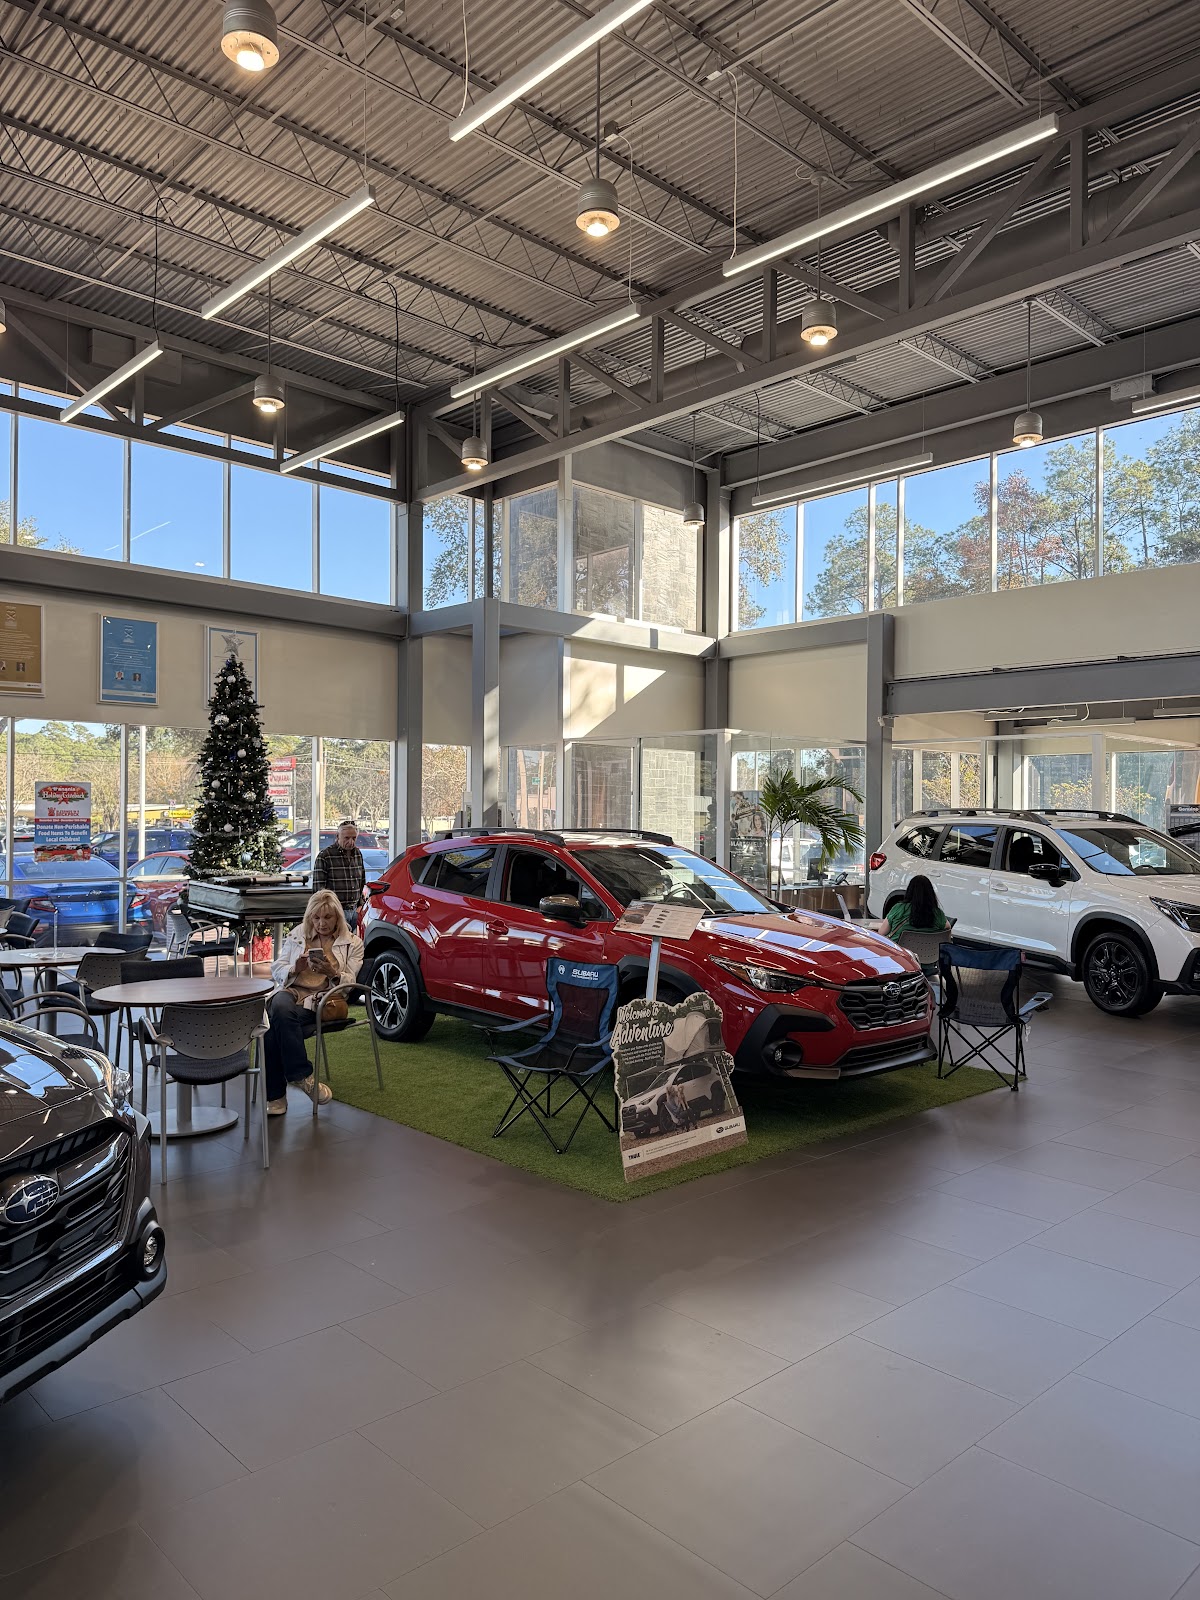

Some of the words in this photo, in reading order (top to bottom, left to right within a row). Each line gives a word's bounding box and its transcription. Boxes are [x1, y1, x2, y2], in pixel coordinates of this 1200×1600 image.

[572, 969, 599, 977] SUBARU
[618, 1006, 651, 1024] Welcome
[651, 1002, 659, 1017] to
[611, 1017, 673, 1048] Adventure
